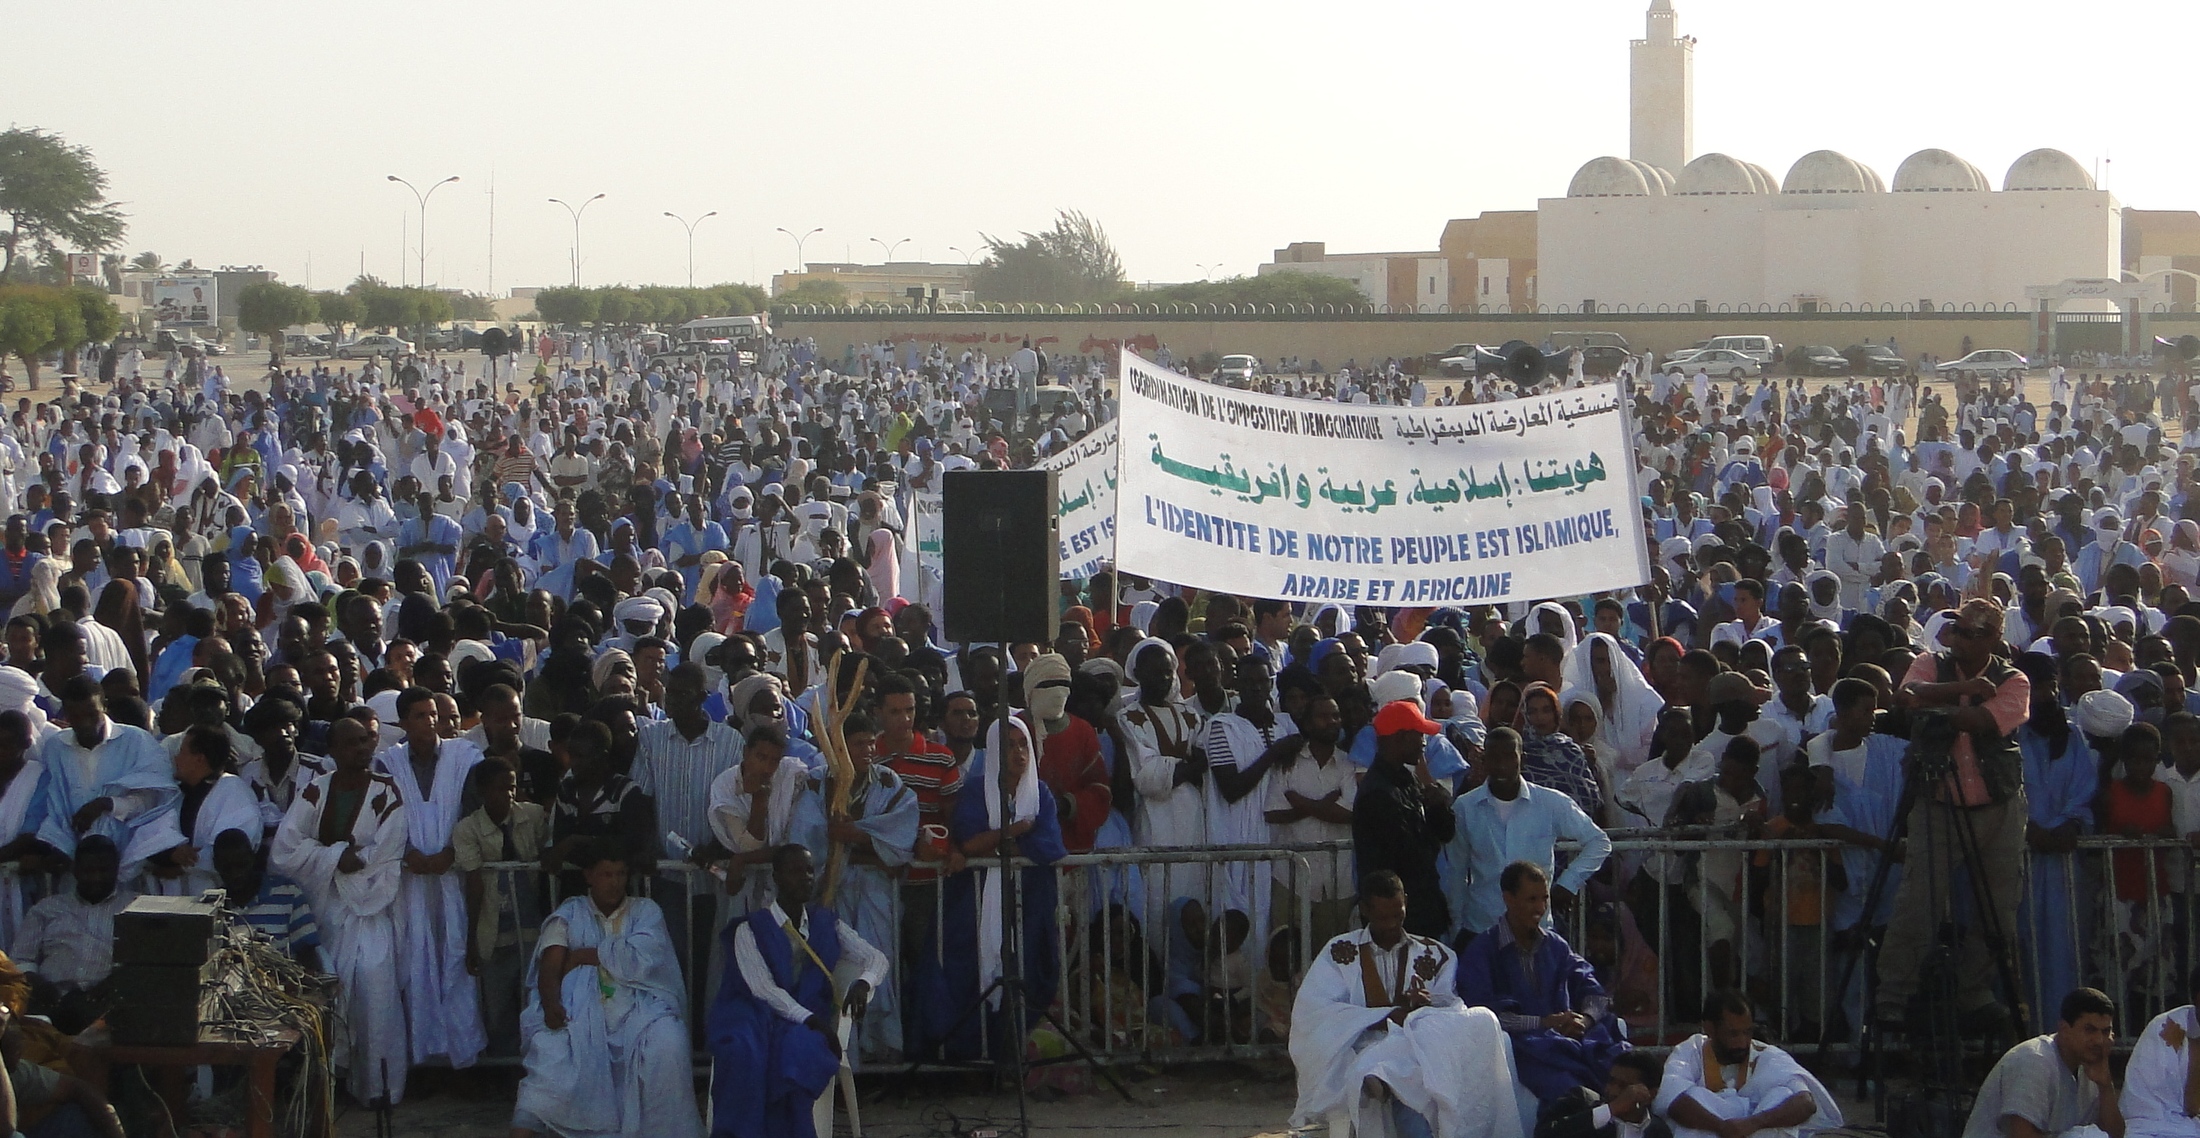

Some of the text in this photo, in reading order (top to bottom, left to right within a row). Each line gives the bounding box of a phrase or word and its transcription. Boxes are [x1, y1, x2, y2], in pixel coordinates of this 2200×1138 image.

[1129, 366, 1384, 440] COORDINATION DE L'OPPOSITION DEMOCRATIQUE
[1391, 393, 1620, 445] منسقية المعارضة الديمقراطية
[1317, 466, 1398, 514] عربية
[1070, 525, 1099, 555] EST
[1145, 494, 1261, 553] L'IDENTITE
[1268, 527, 1299, 559] DE
[1307, 532, 1384, 564] NOTRE
[1390, 533, 1470, 564] PEUPLE
[1475, 527, 1510, 559] EST
[1515, 508, 1619, 555] ISLAMIQUE,
[1281, 571, 1512, 602] ARABE ET AFRICAINE
